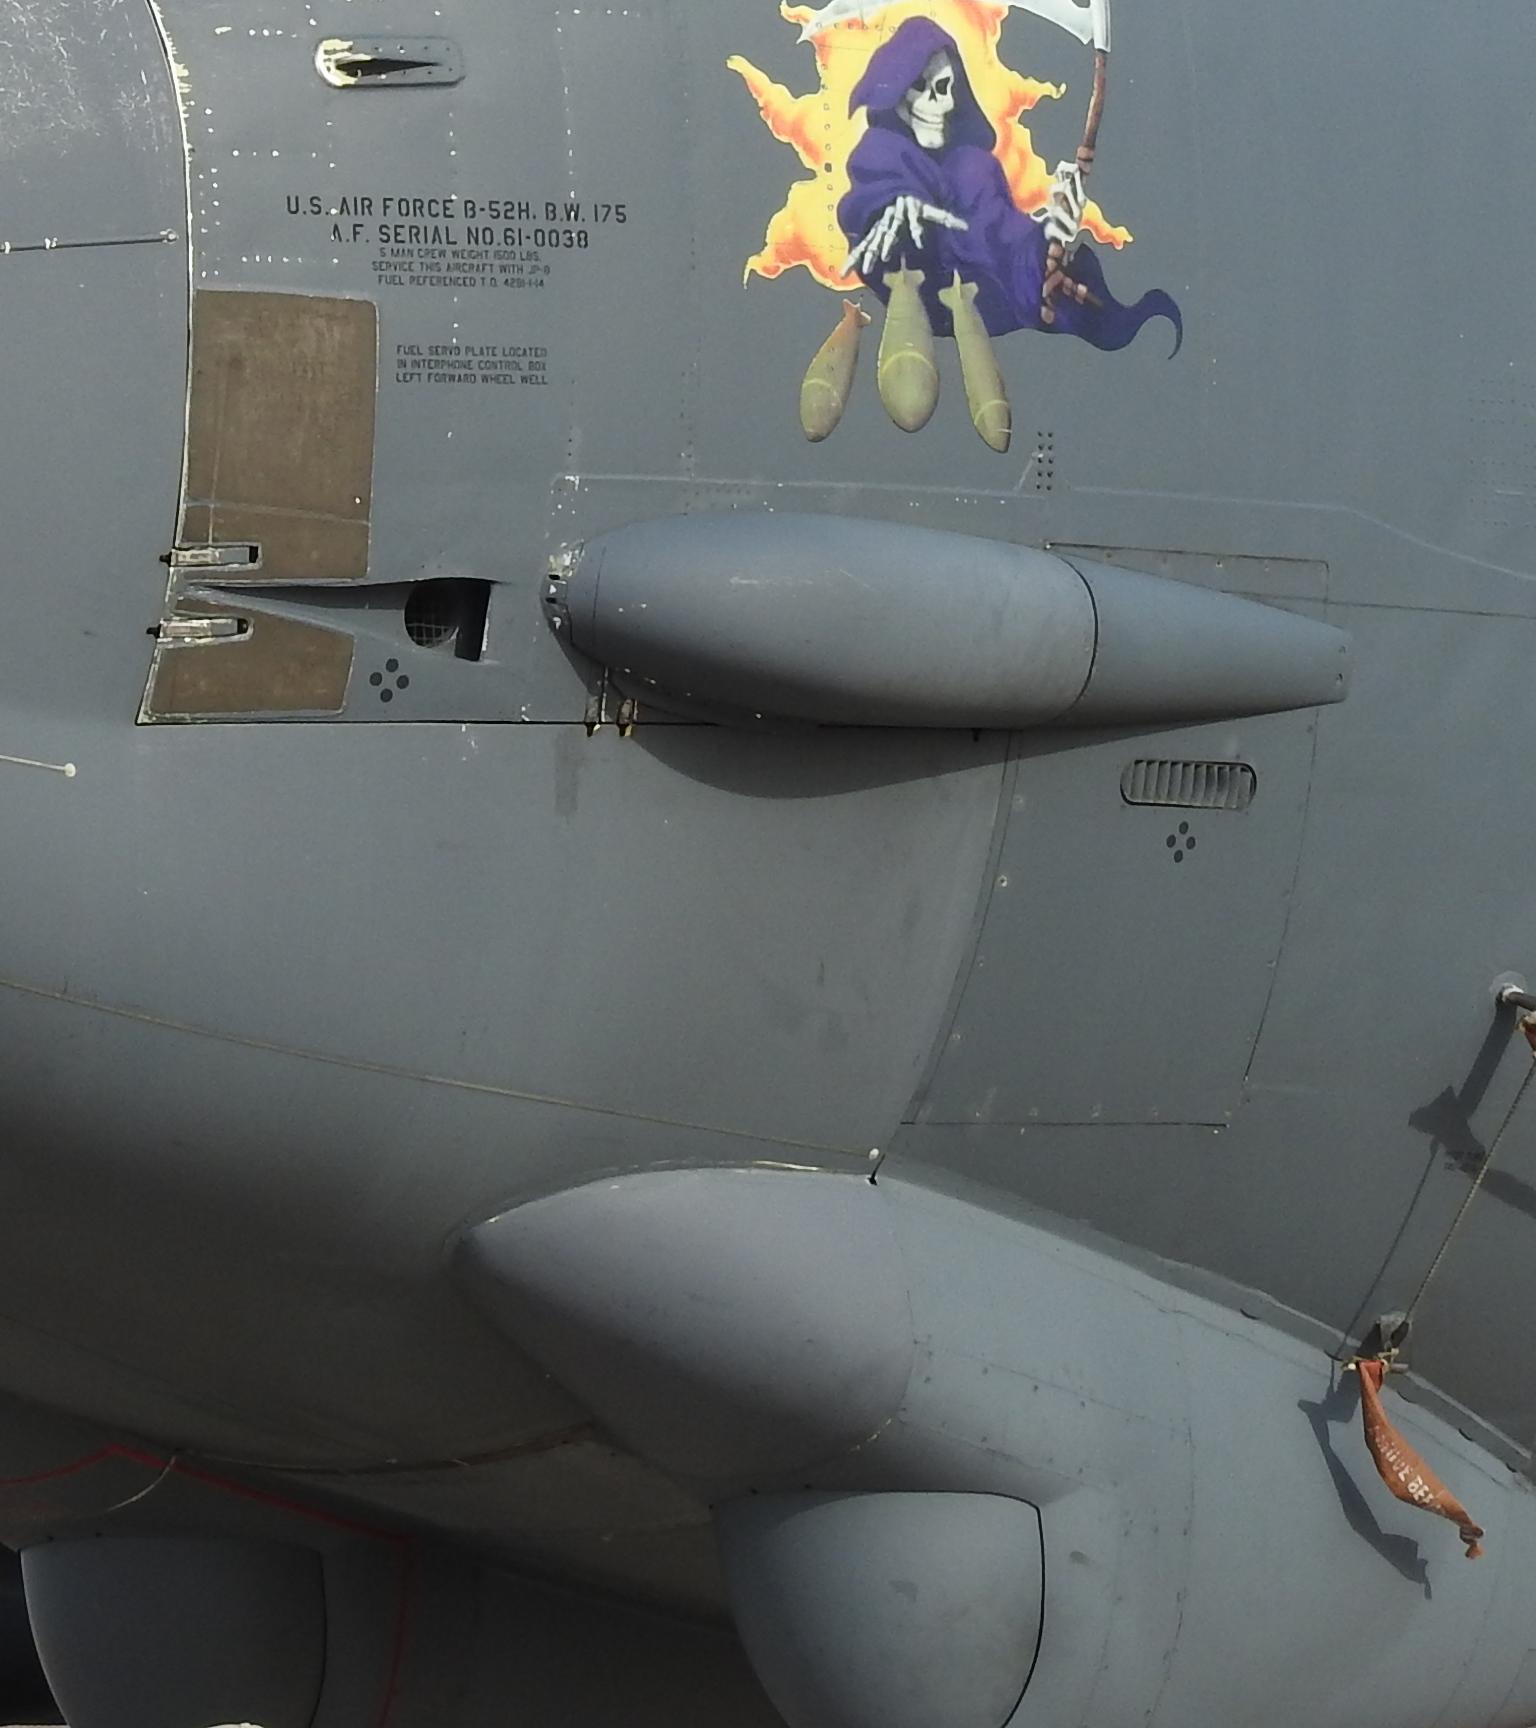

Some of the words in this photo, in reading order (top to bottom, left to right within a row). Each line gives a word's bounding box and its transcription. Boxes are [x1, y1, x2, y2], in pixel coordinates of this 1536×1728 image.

[339, 197, 373, 217] AIR
[382, 197, 455, 219] FORCE
[593, 204, 627, 223] 175
[379, 224, 458, 246] SERIAL
[390, 248, 413, 258] MAN
[451, 249, 489, 260] WEIGHT
[371, 261, 414, 272] SERVICE
[419, 261, 442, 273] THIS
[446, 262, 494, 274] AIRCRAFT
[498, 264, 524, 275] WITH
[377, 275, 404, 286] FUEL
[409, 275, 476, 287] REFERENCED
[396, 344, 423, 356] FUEL
[465, 346, 498, 357] PLATE
[502, 346, 548, 358] LOCATED
[396, 359, 407, 369] IN
[410, 359, 473, 370] INTERPHONE
[477, 360, 523, 371] CONTROL
[528, 361, 547, 371] BOX
[395, 372, 422, 383] LEFT
[427, 373, 477, 384] FORWARD
[480, 374, 516, 384] WHEEL
[520, 374, 549, 385] WELL
